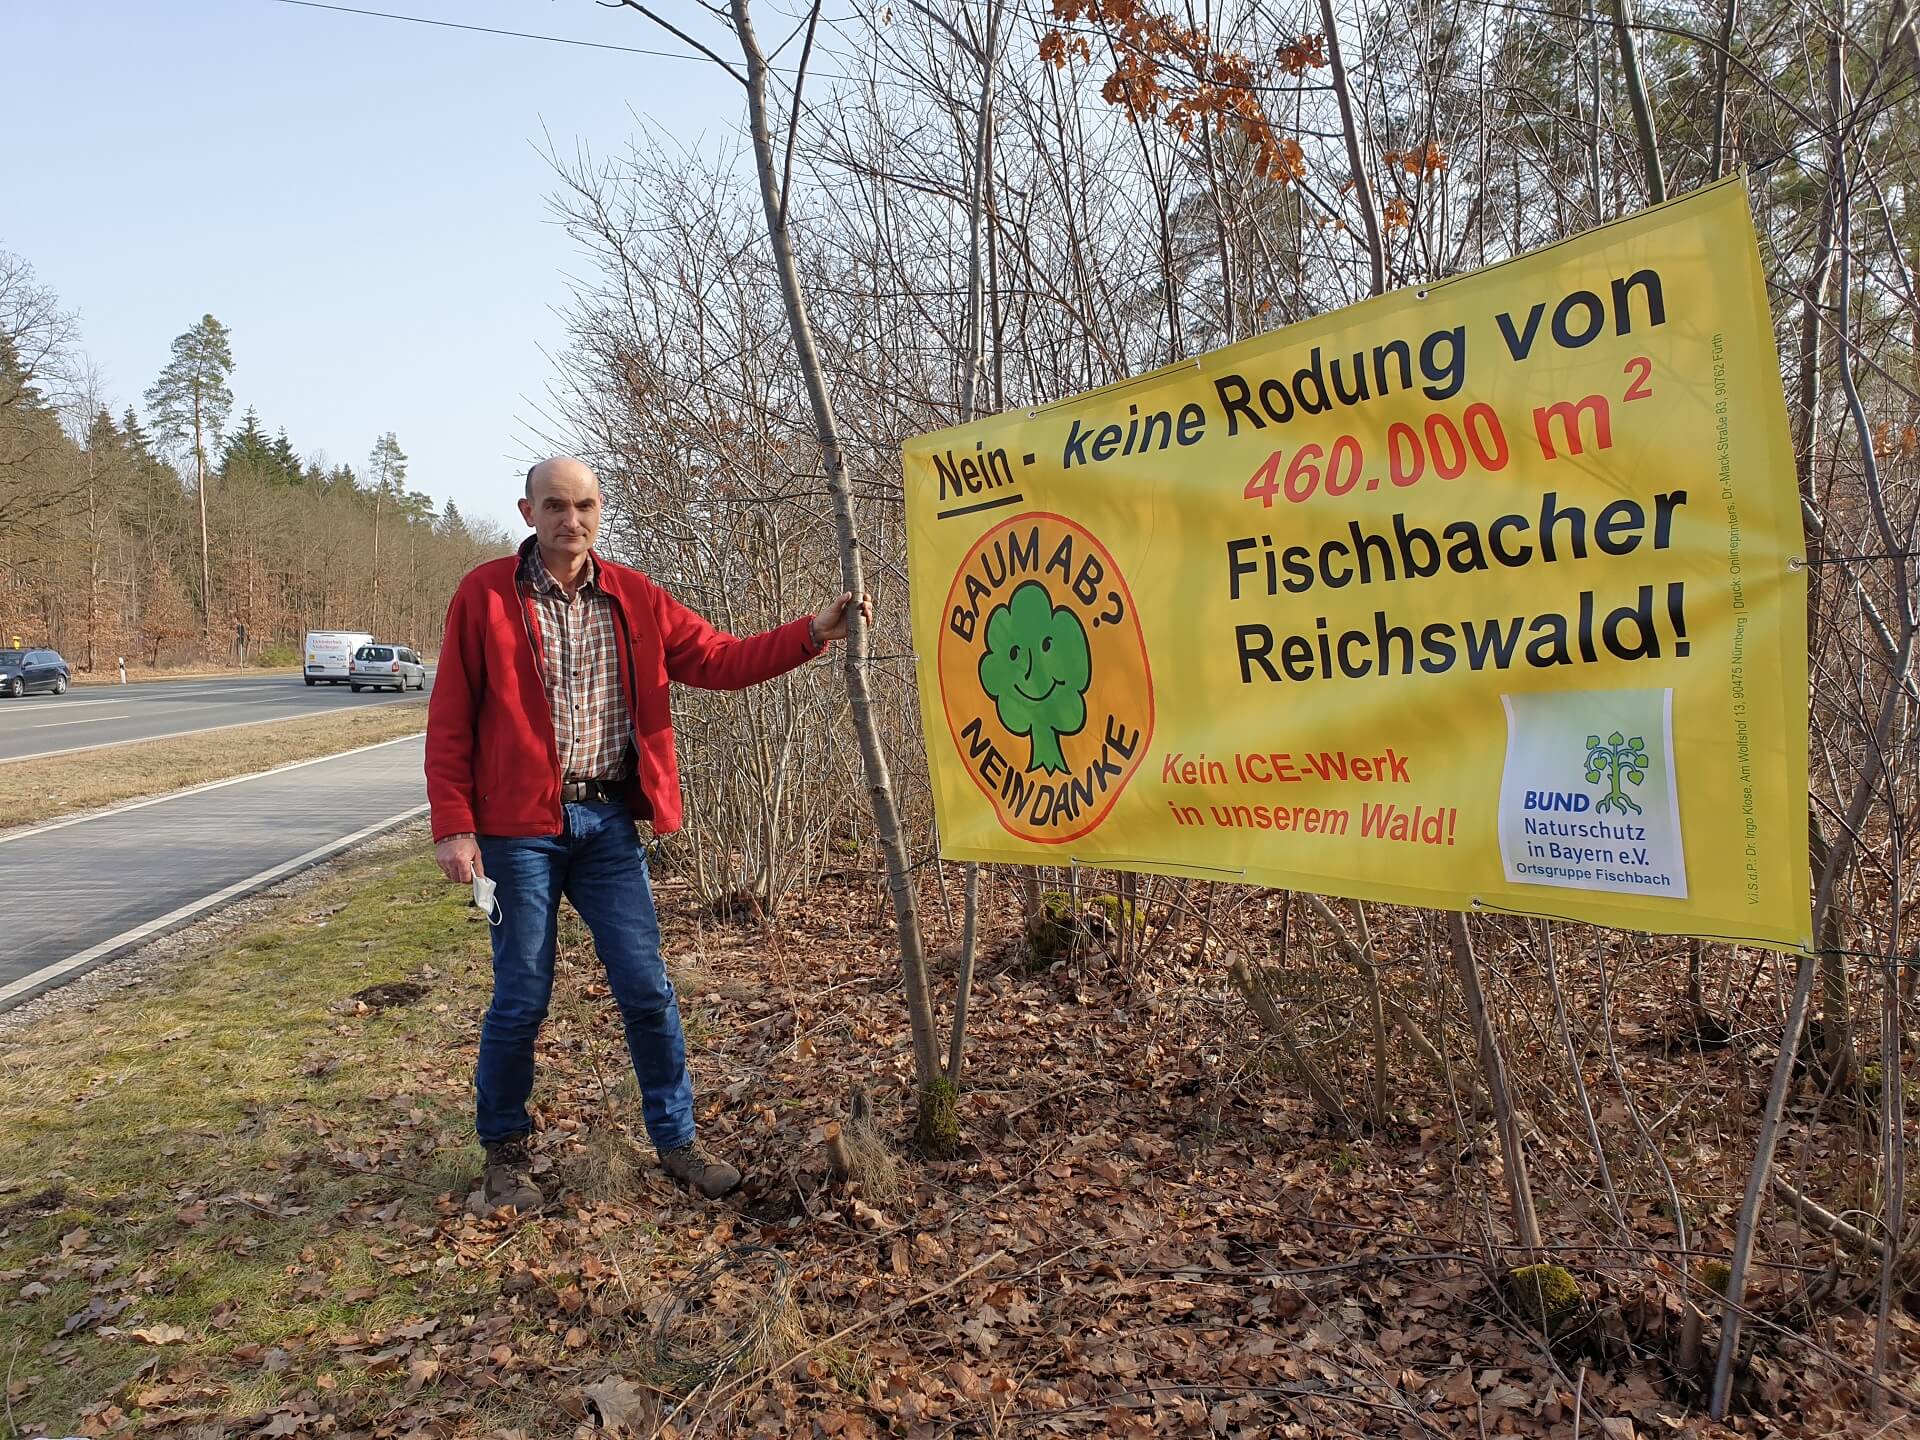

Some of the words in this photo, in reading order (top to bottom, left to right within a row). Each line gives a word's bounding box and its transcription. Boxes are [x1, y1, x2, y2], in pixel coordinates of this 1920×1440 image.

[1712, 333, 1723, 361] Fürth
[933, 441, 1013, 500] Nein
[1022, 452, 1036, 466] -
[1063, 403, 1206, 469] keine
[1214, 326, 1467, 436] Rodung
[1495, 269, 1667, 361] von
[1714, 363, 1726, 396] 90762
[1243, 403, 1509, 508] 460.000
[1227, 490, 1687, 600] Fischbacher
[951, 526, 1039, 643] BAUM
[1731, 577, 1745, 609] Druck:
[1235, 582, 1690, 683] Reichswald!
[1732, 617, 1748, 665] Nürnberg
[1732, 667, 1744, 698] 90475
[1734, 701, 1746, 716] 13,
[1735, 719, 1750, 763] Wolfshof
[961, 717, 1034, 817] NEIN
[1030, 715, 1139, 826] DANKE
[1162, 753, 1228, 785] Kein
[1235, 749, 1411, 783] ICE-Werk
[1740, 765, 1751, 782] Am
[1523, 790, 1589, 813] BUND
[1168, 801, 1203, 826] in
[1215, 803, 1349, 835] unserem
[1360, 803, 1458, 846] Wald!
[1524, 818, 1645, 841] Naturschutz
[1745, 817, 1757, 839] Ingo
[1527, 841, 1544, 858] in
[1550, 842, 1614, 867] Bayern
[1619, 847, 1649, 867] e.V.
[1746, 842, 1757, 856] Dr.
[1516, 862, 1592, 881] Ortsgruppe
[1596, 868, 1671, 886] Fischbach
